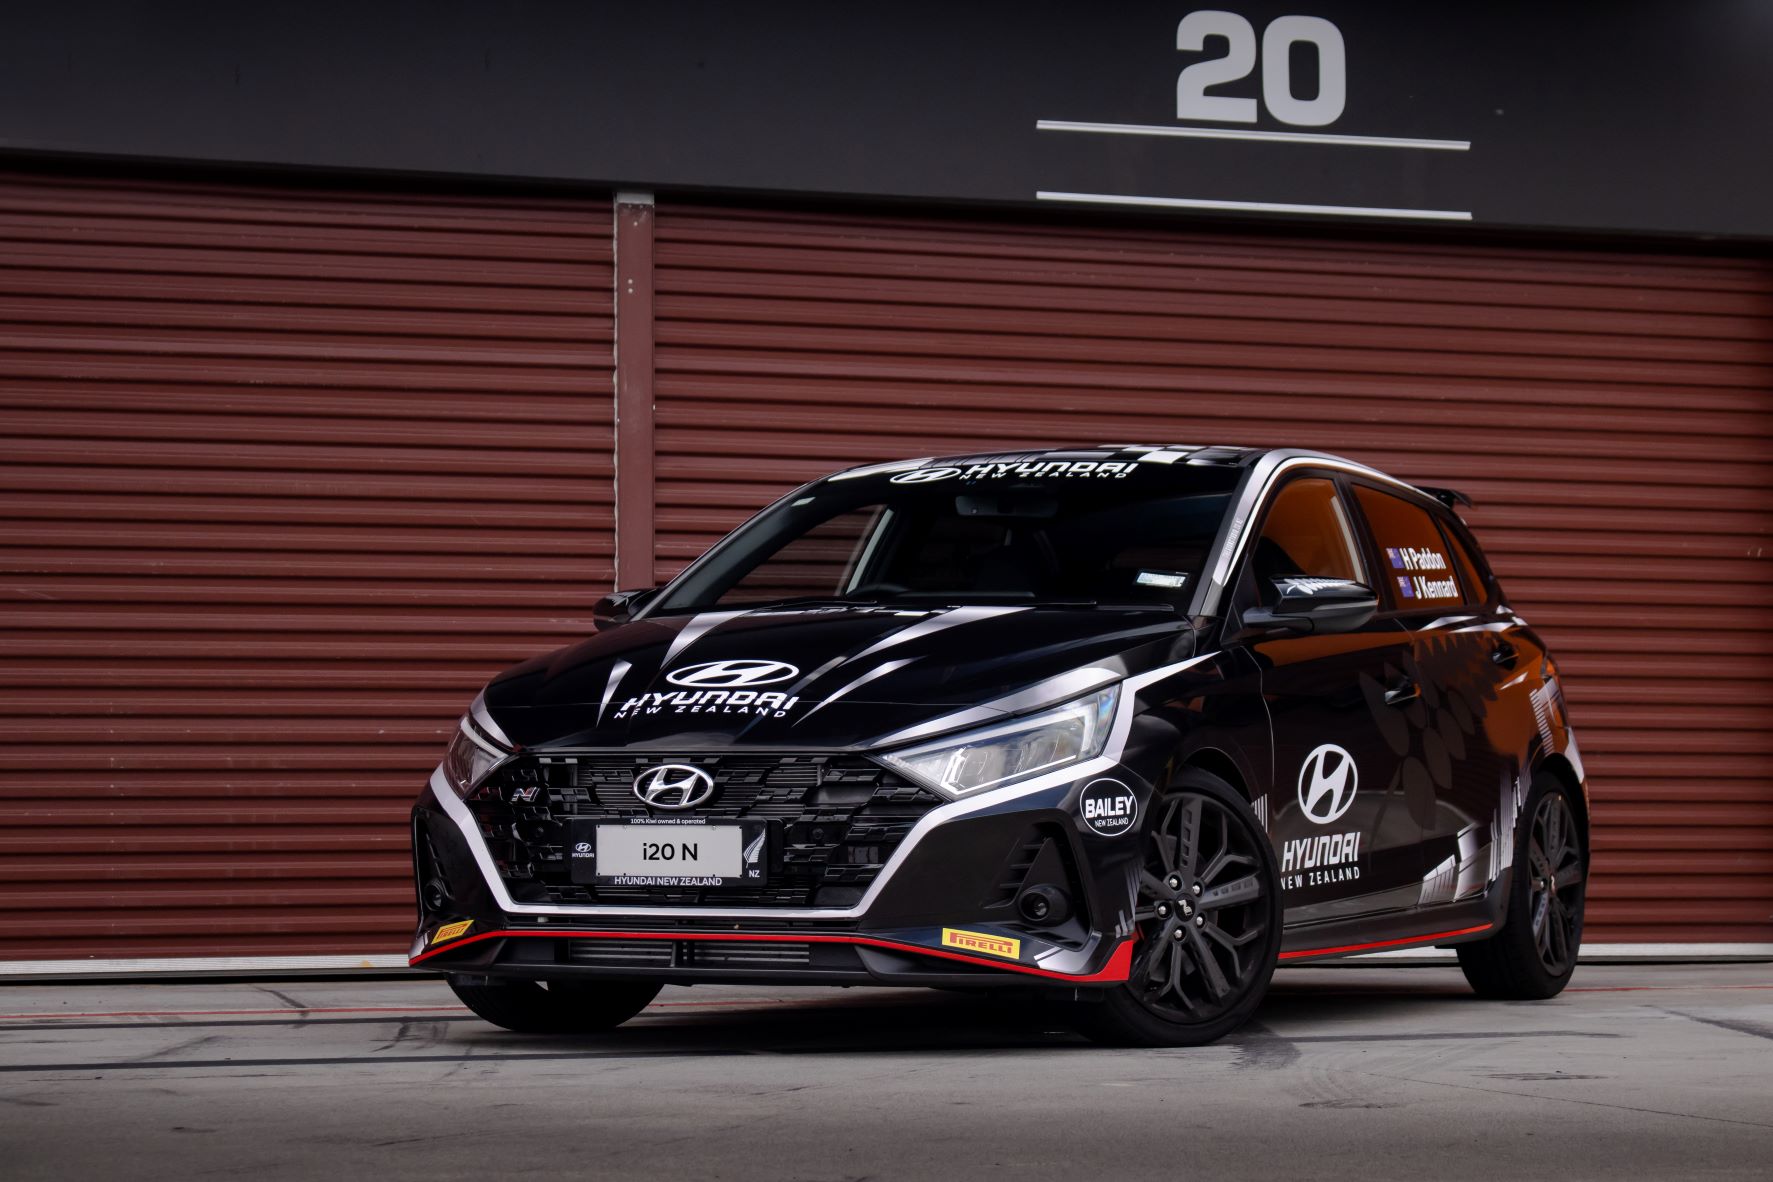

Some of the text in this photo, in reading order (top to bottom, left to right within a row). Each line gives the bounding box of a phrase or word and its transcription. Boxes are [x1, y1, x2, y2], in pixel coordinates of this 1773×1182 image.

[1176, 10, 1347, 126] 20
[965, 462, 1139, 475] HYUNDAI
[1399, 547, 1446, 570] H Paddon
[1413, 575, 1458, 599] J Kennard
[620, 691, 800, 710] HYUNDAI
[614, 705, 786, 719] NEW ZEALAND
[1085, 796, 1133, 819] BAILEY
[1094, 817, 1129, 828] NEW ZEALAND
[643, 842, 698, 861] i20 N
[1281, 831, 1361, 873] HYUNDAI
[614, 876, 722, 886] HYUNDAI NEW ZEALAND
[748, 870, 760, 878] NZ
[1280, 866, 1360, 890] NEW ZEALAND
[949, 931, 1014, 954] PIRELLI
